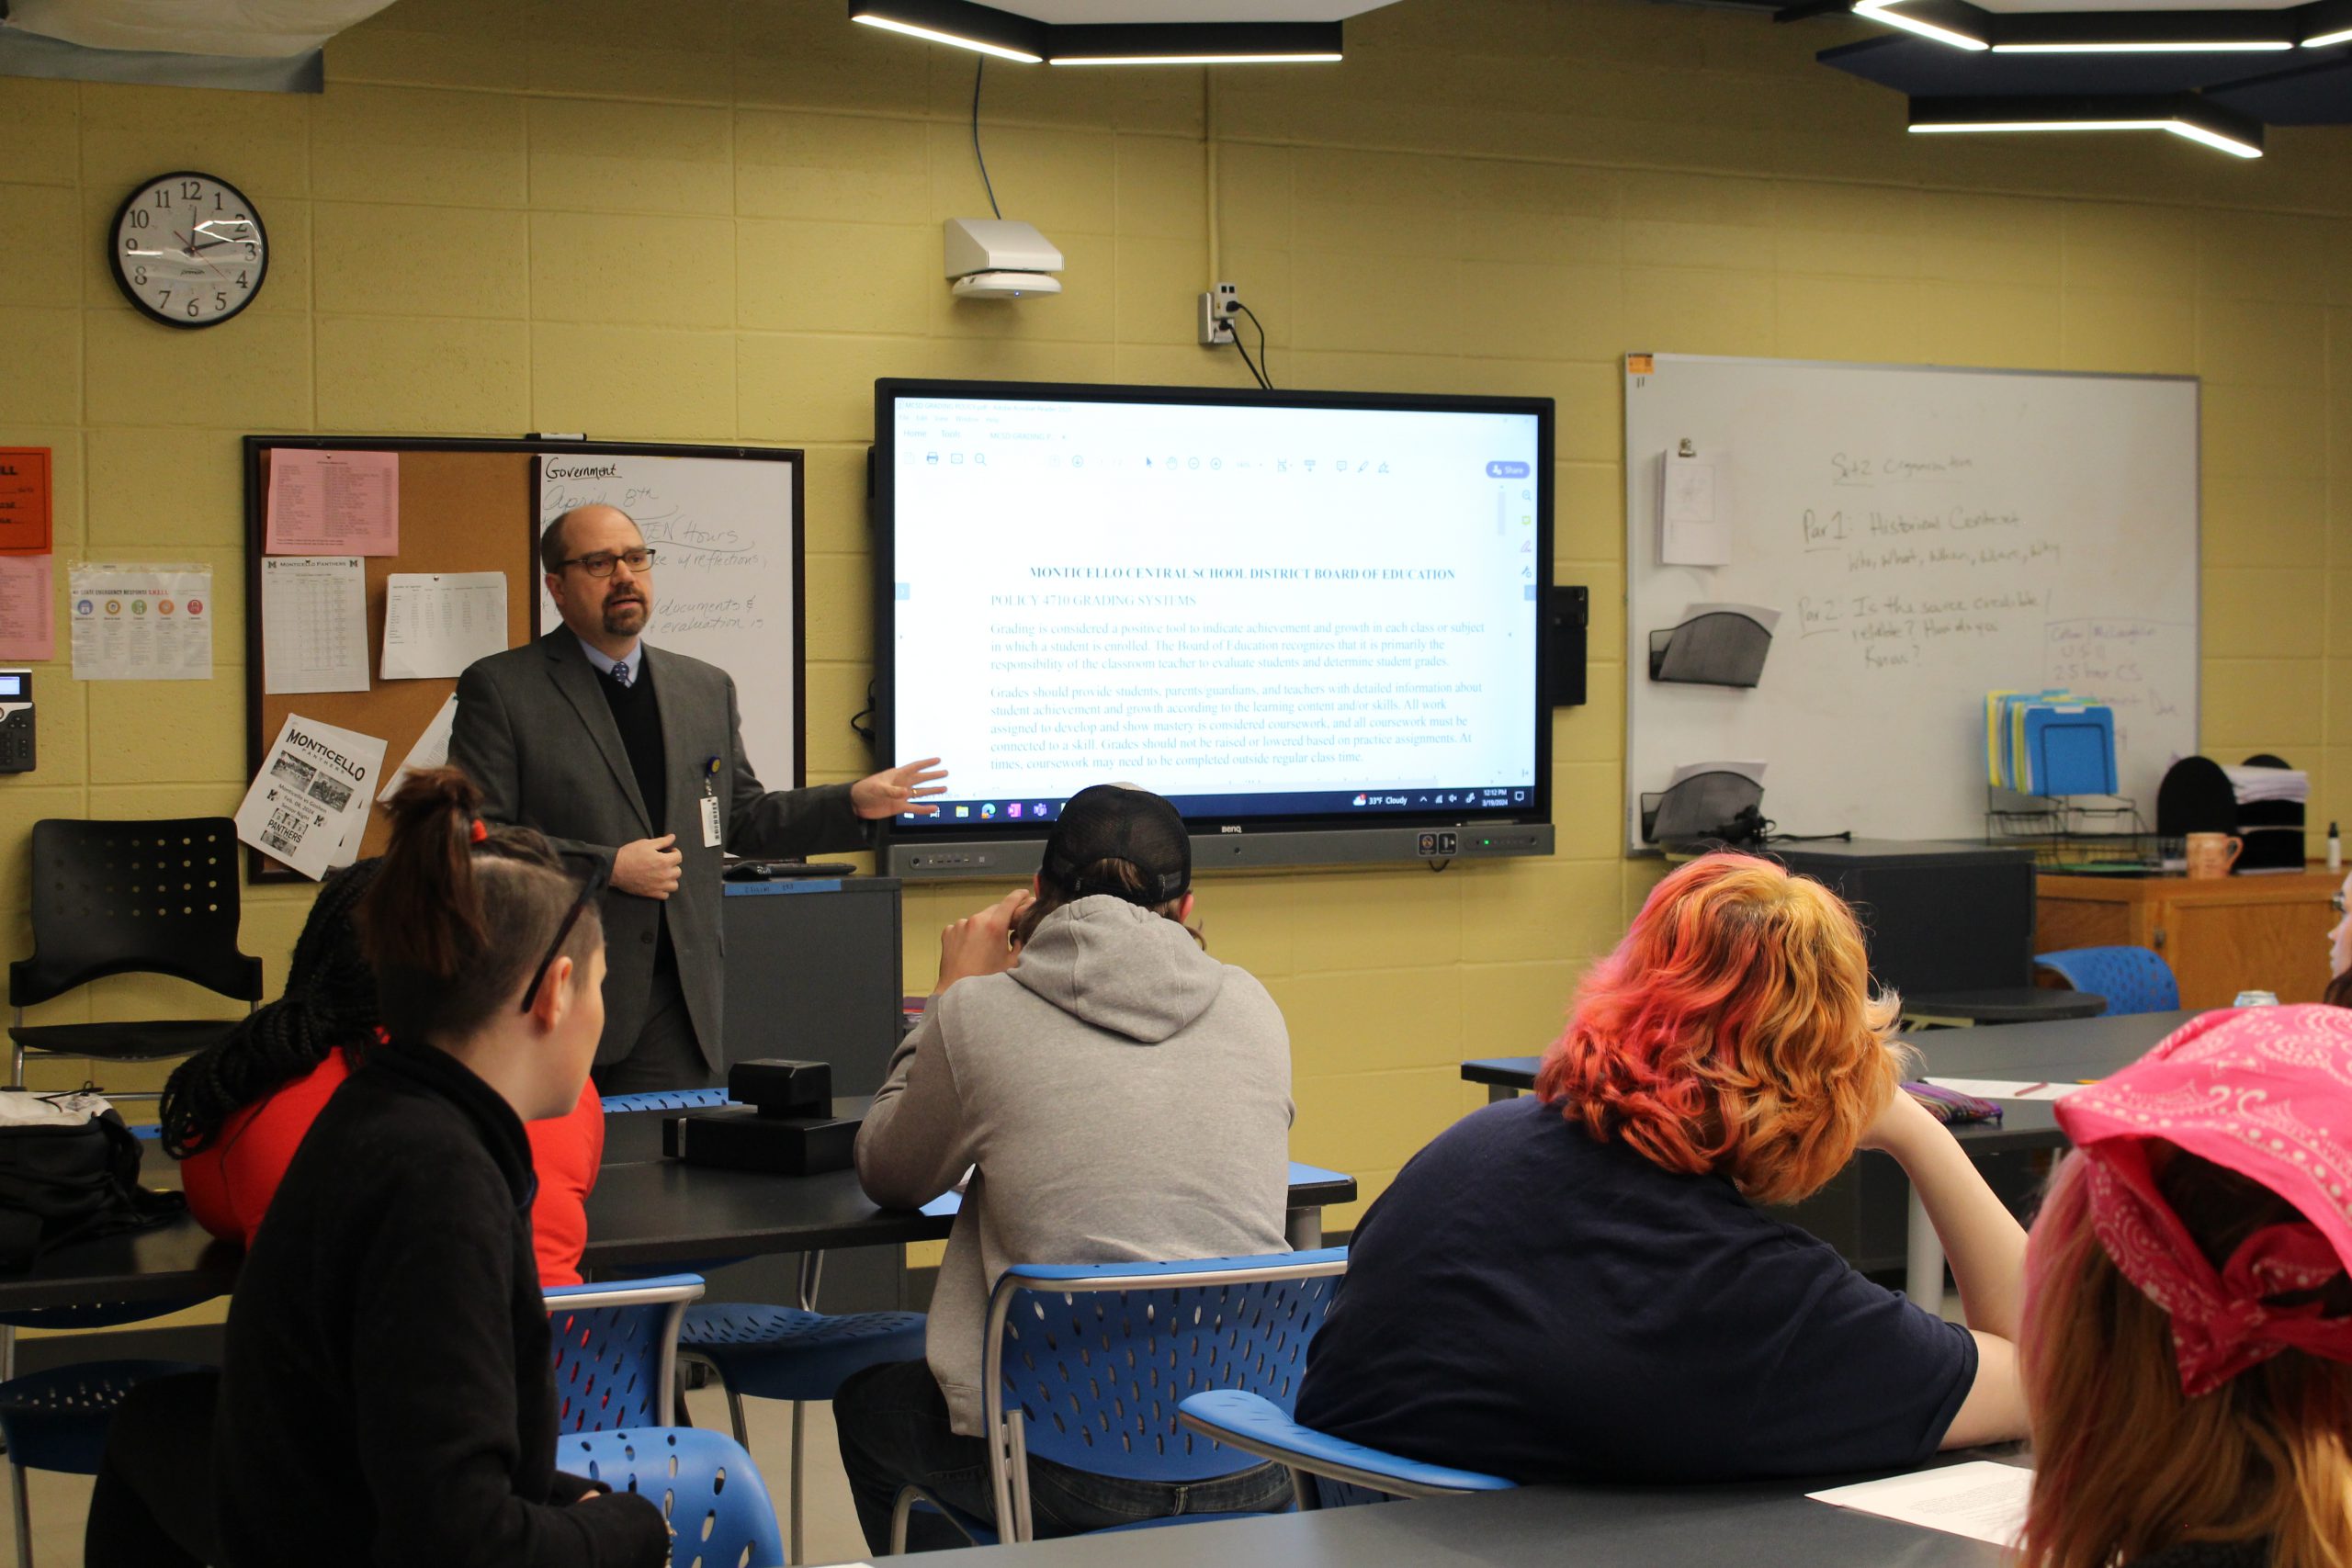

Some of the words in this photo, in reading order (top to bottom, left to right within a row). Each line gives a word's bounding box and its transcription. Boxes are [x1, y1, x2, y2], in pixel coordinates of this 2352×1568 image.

[155, 189, 171, 209] 11
[181, 182, 202, 200] 12
[215, 192, 222, 210] 1
[130, 209, 150, 229] 10
[235, 214, 248, 232] 2
[126, 238, 138, 257] 9
[245, 243, 256, 262] 3
[135, 266, 148, 286] 8
[235, 270, 248, 289] 4
[158, 290, 171, 310] 7
[187, 299, 199, 317] 6
[215, 292, 227, 311] 5
[546, 457, 616, 479] Government
[1505, 465, 1524, 475] Share
[1030, 568, 1123, 578] MONTICELLO
[1126, 568, 1190, 578] CENTRAL
[1193, 569, 1246, 578] SCHOOL
[1250, 569, 1311, 579] DISTRICT
[1315, 569, 1359, 579] BOARD
[1363, 570, 1378, 580] OF
[1383, 570, 1454, 580] EDUCATION
[991, 595, 1038, 605] POLICY
[1044, 595, 1069, 605] 4710
[1073, 595, 1134, 605] GRADING
[1138, 595, 1196, 606] SYSTEMS
[991, 623, 1035, 637] Grading
[1040, 626, 1047, 634] is
[1051, 623, 1108, 634] considered
[1113, 625, 1117, 634] a
[1121, 625, 1162, 636] positive
[1167, 623, 1185, 633] tool
[1190, 625, 1200, 634] to
[1203, 623, 1243, 634] indicate
[1247, 623, 1310, 633] achievement
[1314, 622, 1331, 633] and
[1335, 623, 1370, 636] growth
[1374, 622, 1382, 633] in
[1385, 622, 1408, 633] each
[1411, 623, 1434, 633] class
[1451, 622, 1484, 635] subject
[992, 644, 1001, 652] in
[1006, 641, 1037, 652] which
[1041, 643, 1046, 651] a
[1051, 641, 1088, 651] student
[1093, 643, 1101, 651] is
[1157, 640, 1174, 651] The
[1178, 640, 1209, 651] Board
[1213, 639, 1223, 650] of
[1227, 639, 1278, 651] Education
[1282, 642, 1335, 653] recognizes
[1338, 639, 1356, 650] that
[1361, 639, 1366, 650] it
[1371, 639, 1378, 650] is
[1382, 639, 1426, 652] primarily
[1430, 639, 1444, 649] the
[991, 659, 1062, 671] responsibility
[1068, 660, 1078, 669] of
[1082, 659, 1098, 669] the
[1102, 659, 1155, 669] classroom
[1159, 658, 1195, 669] teacher
[1199, 660, 1209, 668] to
[1213, 658, 1255, 668] evaluate
[1258, 657, 1299, 668] students
[1303, 657, 1320, 667] and
[1324, 657, 1374, 667] determine
[1377, 656, 1411, 667] student
[991, 687, 1029, 698] Grades
[1033, 686, 1068, 698] should
[1072, 686, 1112, 699] provide
[1262, 684, 1281, 695] and
[1284, 683, 1325, 694] teachers
[1329, 683, 1350, 694] with
[1353, 682, 1392, 694] detailed
[1396, 682, 1452, 694] information
[1455, 682, 1481, 693] about
[991, 705, 1029, 716] student
[1034, 705, 1101, 716] achievement
[1104, 704, 1123, 714] and
[1126, 703, 1163, 716] growth
[1168, 703, 1217, 716] according
[1221, 704, 1231, 713] to
[1235, 702, 1250, 713] the
[1253, 701, 1294, 715] learning
[1297, 702, 1334, 711] content
[1405, 698, 1419, 710] All
[1422, 699, 1446, 709] work
[286, 729, 366, 781] MONTICELLO
[302, 749, 345, 774] PANTHERS
[1385, 795, 1408, 807] Cloudy
[268, 819, 302, 843] PANTHERS
